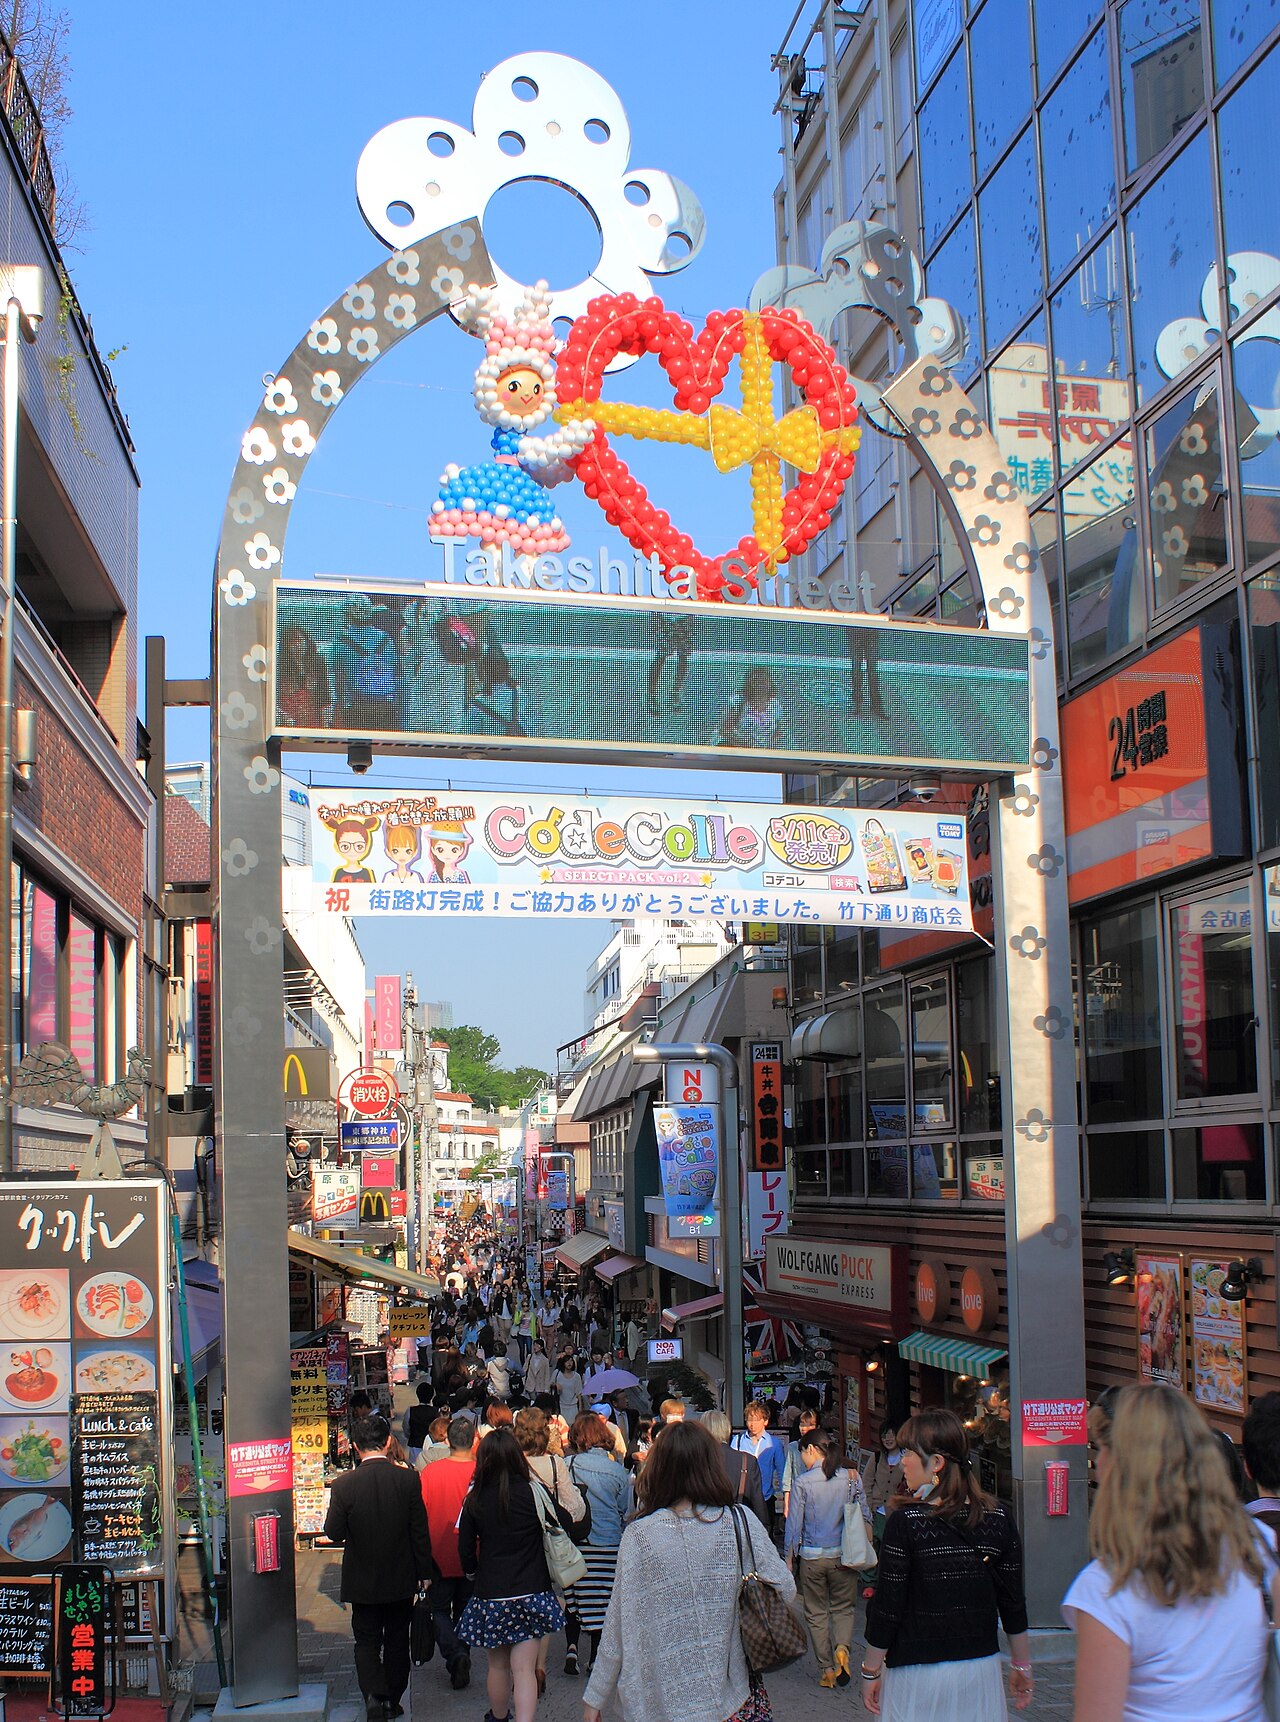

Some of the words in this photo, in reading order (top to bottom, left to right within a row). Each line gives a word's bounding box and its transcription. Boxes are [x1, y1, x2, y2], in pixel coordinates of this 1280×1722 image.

[430, 535, 698, 599] Takeshita
[721, 558, 881, 614] Street
[1108, 707, 1139, 782] 24
[319, 797, 436, 820] ネットで憧れのブランド
[387, 806, 475, 825] 着せ替え放題!!
[770, 818, 850, 845] 5/11(金)
[785, 841, 840, 865] 発売!
[564, 870, 616, 881] SELECT
[618, 872, 655, 882] PACK
[658, 873, 691, 884] vol.2
[764, 875, 805, 886] コデコレ
[834, 876, 854, 888] 検索
[324, 888, 350, 912] 祝
[838, 901, 962, 925] 竹下通り商店会
[751, 930, 776, 941] 3F
[197, 941, 209, 983] CAFE
[383, 983, 395, 1044] DAISO
[197, 992, 211, 1076] INTERNET
[755, 1048, 766, 1060] 24
[353, 1086, 387, 1102] 消火栓
[352, 1126, 388, 1135] 東郷神社
[777, 1246, 839, 1276] WOLFGANG
[841, 1253, 874, 1281] PUCK
[841, 1283, 875, 1300] EXPRESS
[918, 1282, 934, 1302] live
[961, 1288, 982, 1310] love
[1023, 1401, 1084, 1416] 竹下通り公式マップ
[119, 1419, 128, 1431] &
[71, 1623, 95, 1696] 営業中
